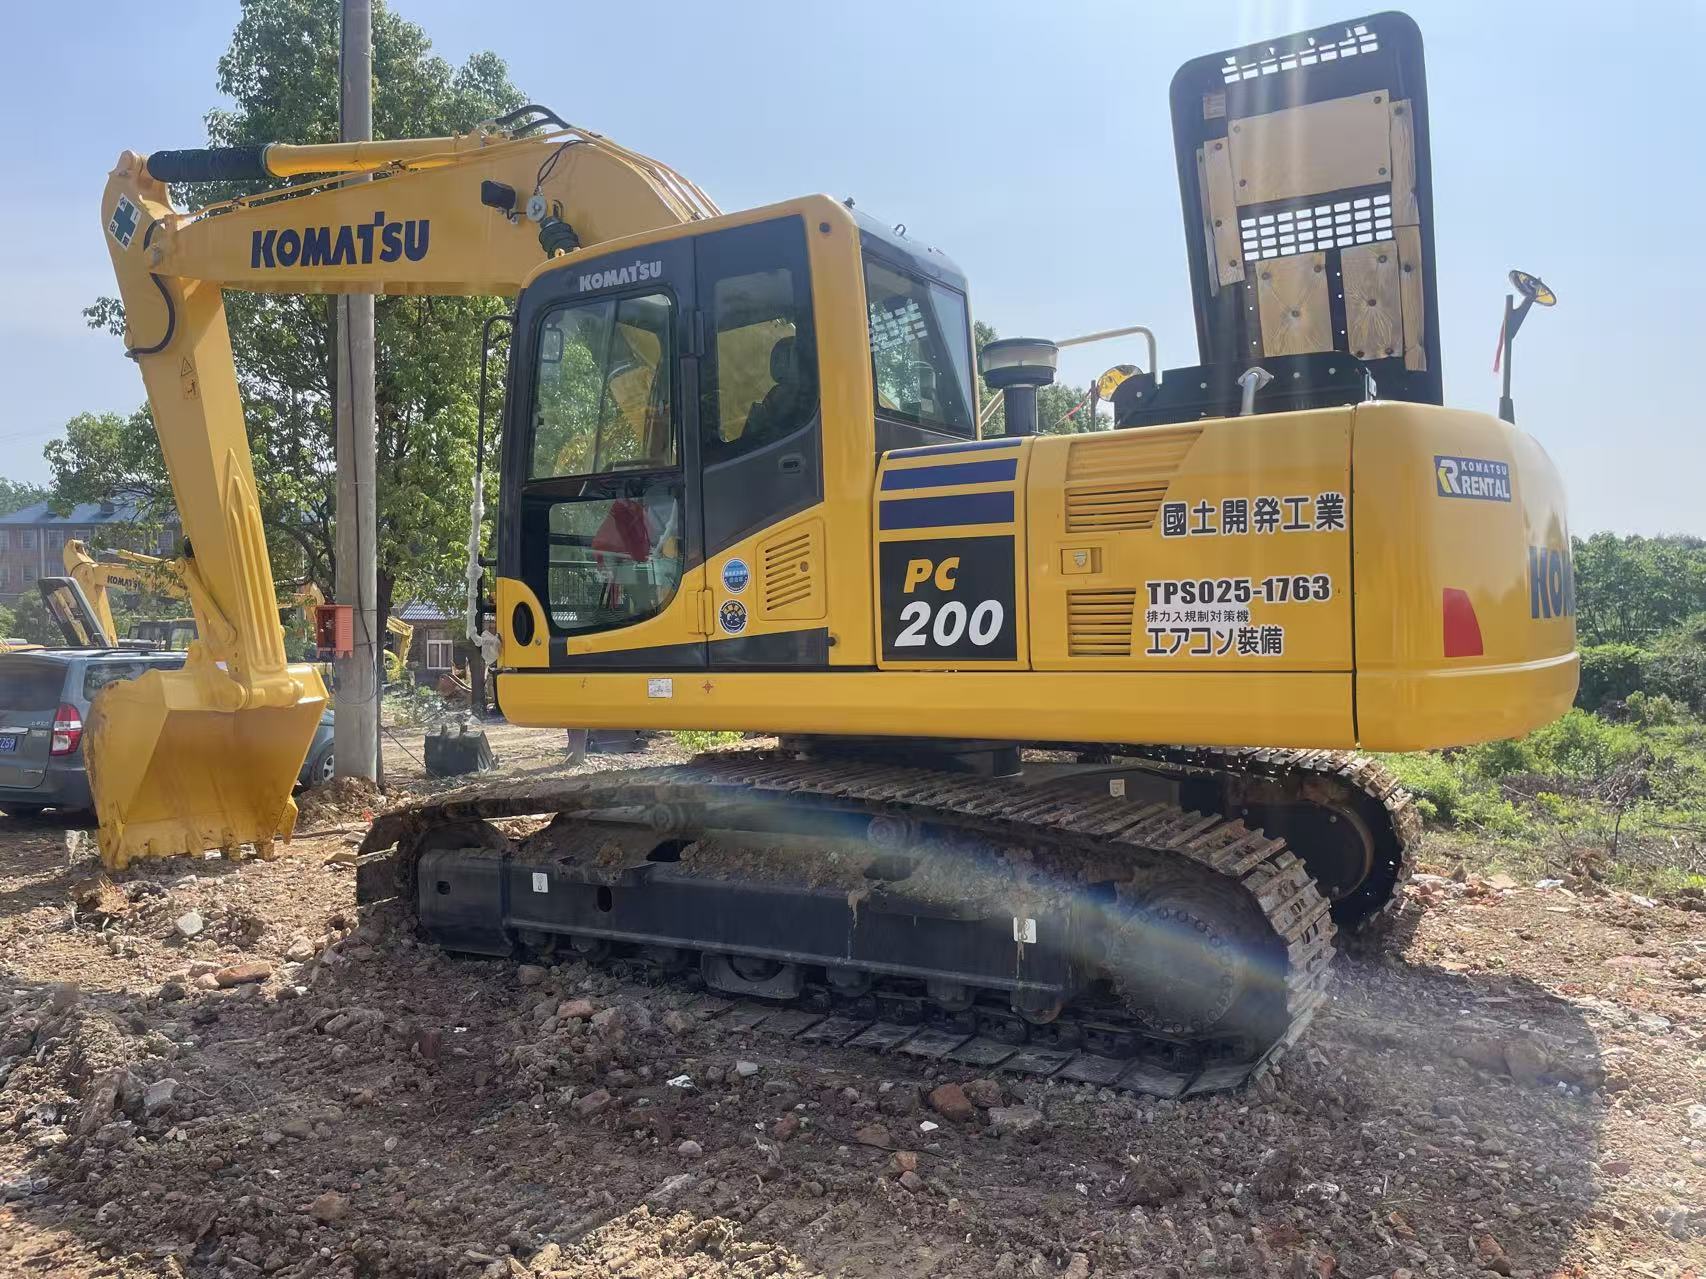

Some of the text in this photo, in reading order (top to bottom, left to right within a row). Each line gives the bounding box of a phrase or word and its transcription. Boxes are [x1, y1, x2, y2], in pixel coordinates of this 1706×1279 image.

[251, 211, 430, 269] KOMATSU
[580, 260, 662, 292] KOMATSU
[1461, 461, 1507, 475] KOMATSU
[1461, 475, 1510, 498] RENTAL
[903, 556, 960, 593] PC
[1146, 575, 1331, 605] TPS025-1763
[894, 599, 1004, 647] 200
